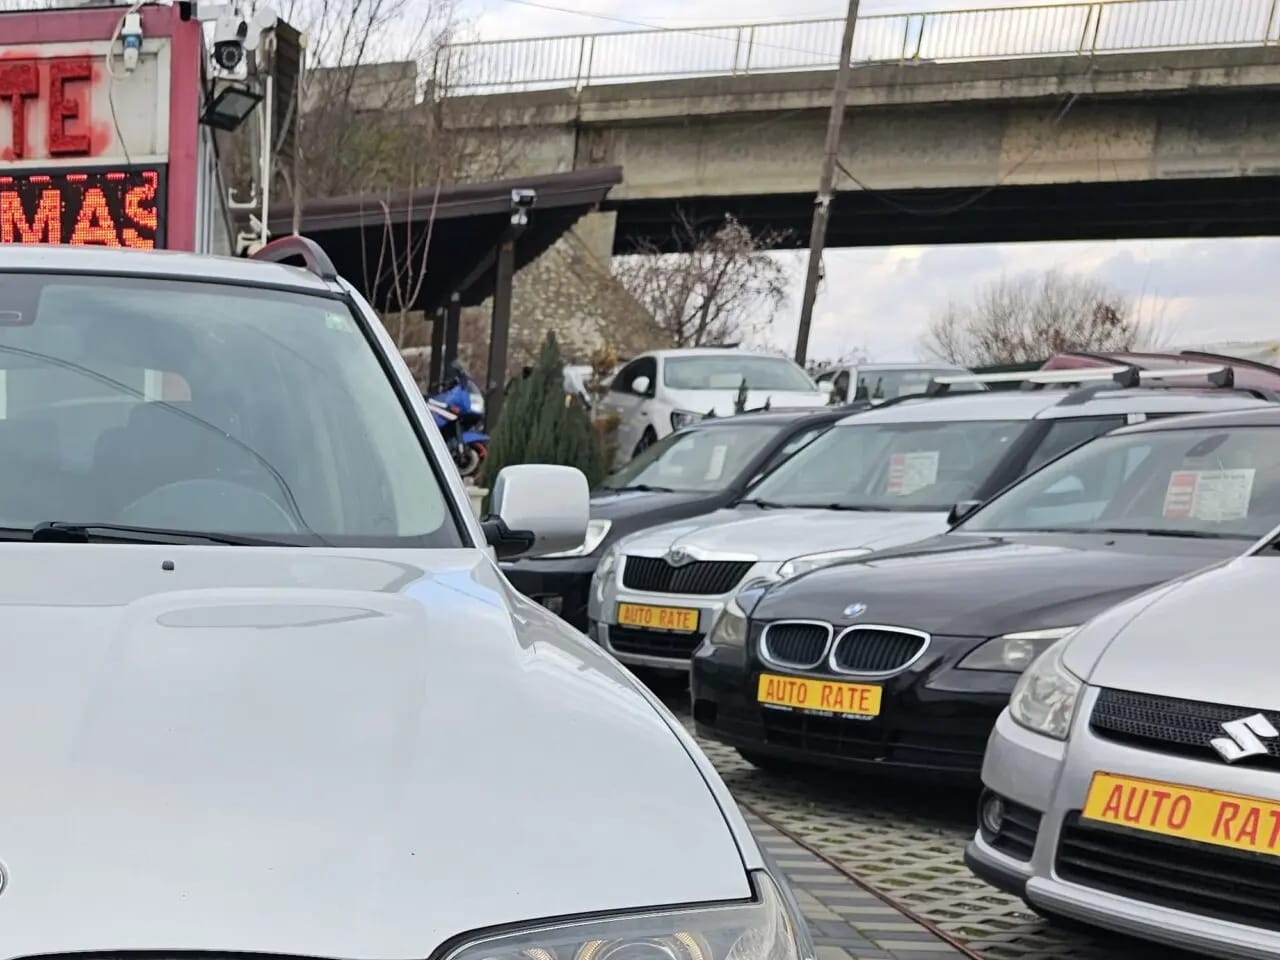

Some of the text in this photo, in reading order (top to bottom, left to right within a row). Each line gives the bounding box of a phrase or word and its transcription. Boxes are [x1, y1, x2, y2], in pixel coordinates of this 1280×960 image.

[623, 605, 691, 628] AUTO RATE
[766, 679, 872, 711] AUTO RATE
[1101, 784, 1192, 829] AUTO
